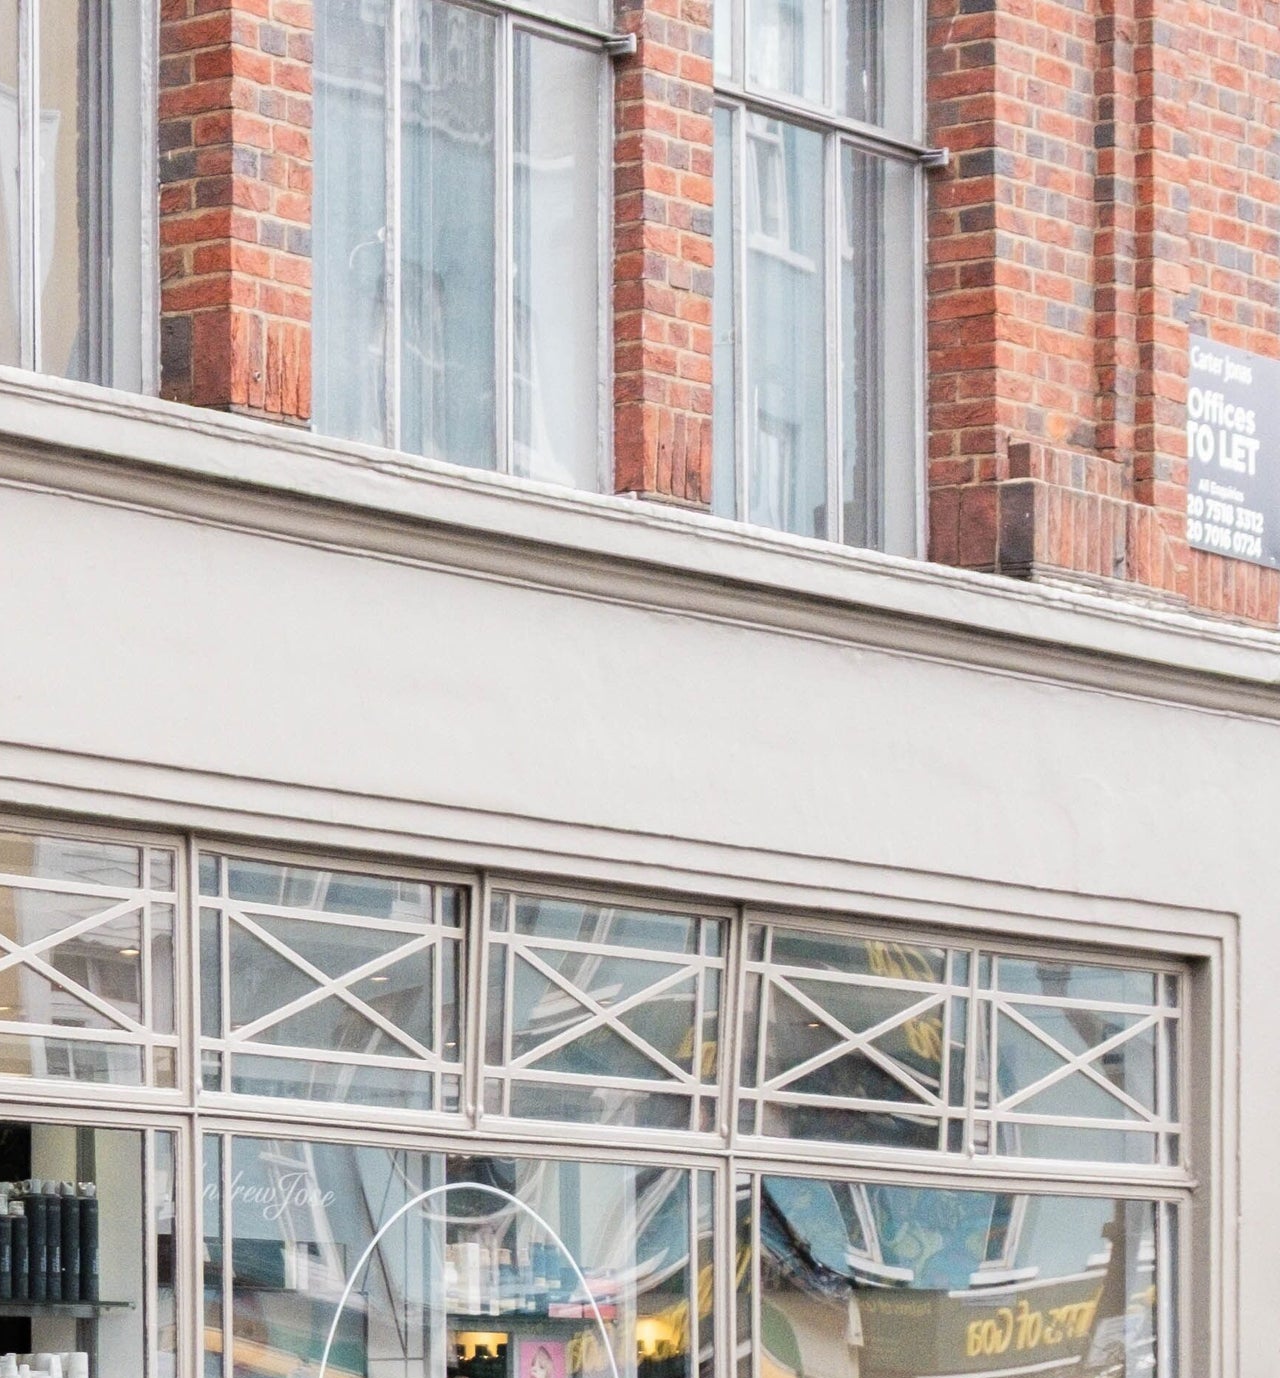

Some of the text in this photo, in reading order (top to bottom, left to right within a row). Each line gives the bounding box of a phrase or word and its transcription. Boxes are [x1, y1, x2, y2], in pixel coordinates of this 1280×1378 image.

[1190, 345, 1253, 385] Carter Jonas
[1187, 386, 1256, 435] Offices
[1186, 420, 1260, 475] TO LET
